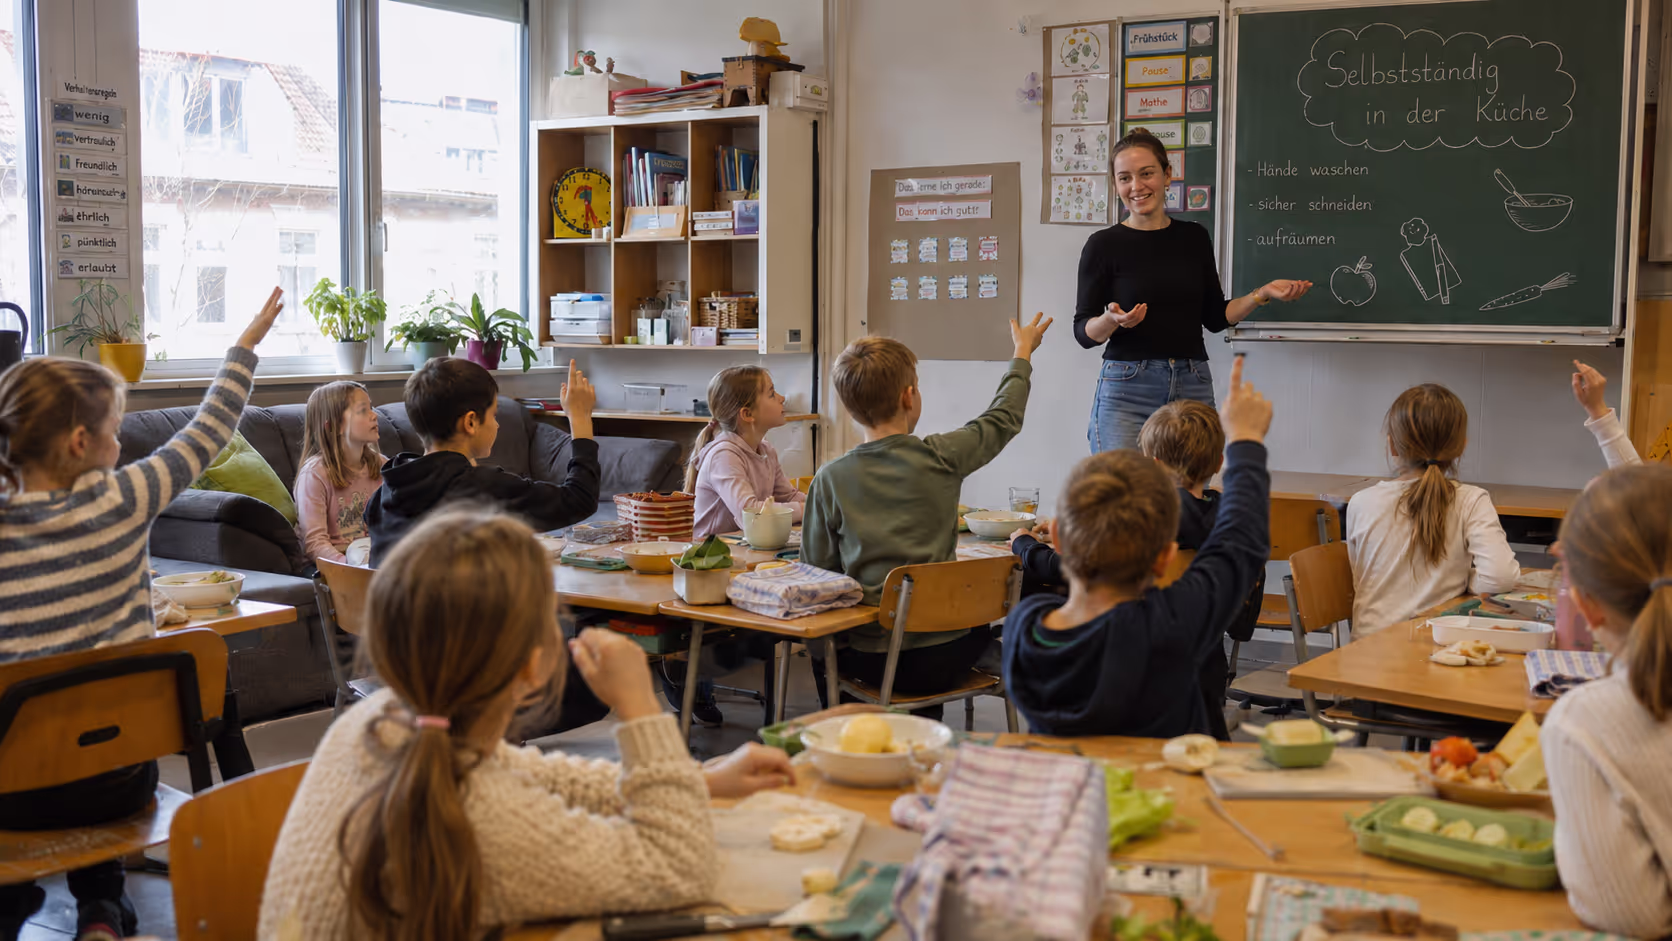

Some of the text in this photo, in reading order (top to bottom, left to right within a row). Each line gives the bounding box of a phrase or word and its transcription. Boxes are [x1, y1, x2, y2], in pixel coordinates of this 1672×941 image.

[1325, 50, 1499, 94] Selbstständig
[1140, 97, 1168, 107] Mathe
[1366, 94, 1549, 125] in der Küche
[75, 111, 110, 124] wenig
[75, 158, 117, 171] Freundlich
[1257, 160, 1298, 177] Hände
[1310, 160, 1369, 176] waschen
[1258, 195, 1297, 210] sicher
[1308, 194, 1372, 211] schneiden
[76, 211, 110, 223] ehrlich
[898, 207, 914, 217] Das
[77, 237, 117, 248] pünktlich
[1256, 227, 1336, 248] aufräumen
[78, 263, 117, 273] erlaubt
